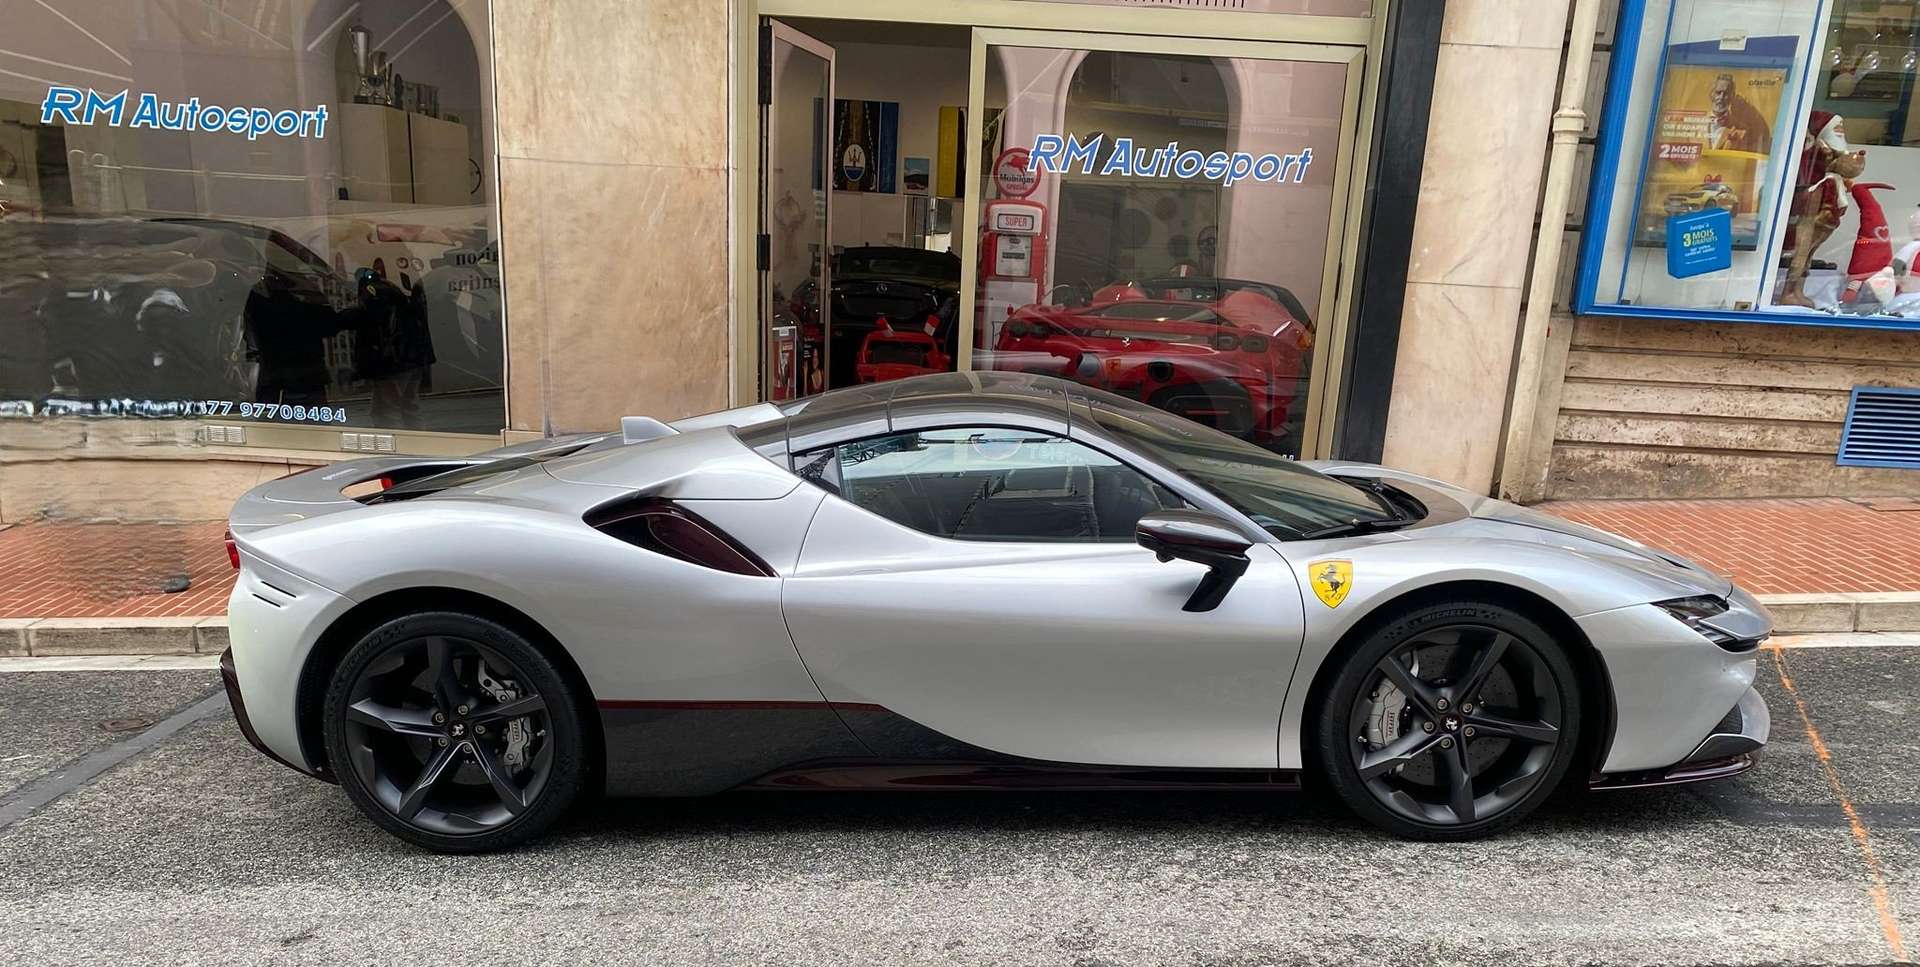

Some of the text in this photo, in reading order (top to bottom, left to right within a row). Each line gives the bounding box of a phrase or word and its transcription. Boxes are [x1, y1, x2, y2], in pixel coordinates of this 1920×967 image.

[40, 86, 329, 141] RM Autosport
[1027, 132, 1313, 187] RM Autosport
[1659, 144, 1698, 159] 2 MOIS
[1005, 216, 1028, 227] SUPER
[1683, 229, 1714, 247] 3 MOIS
[240, 402, 347, 423] 97708484
